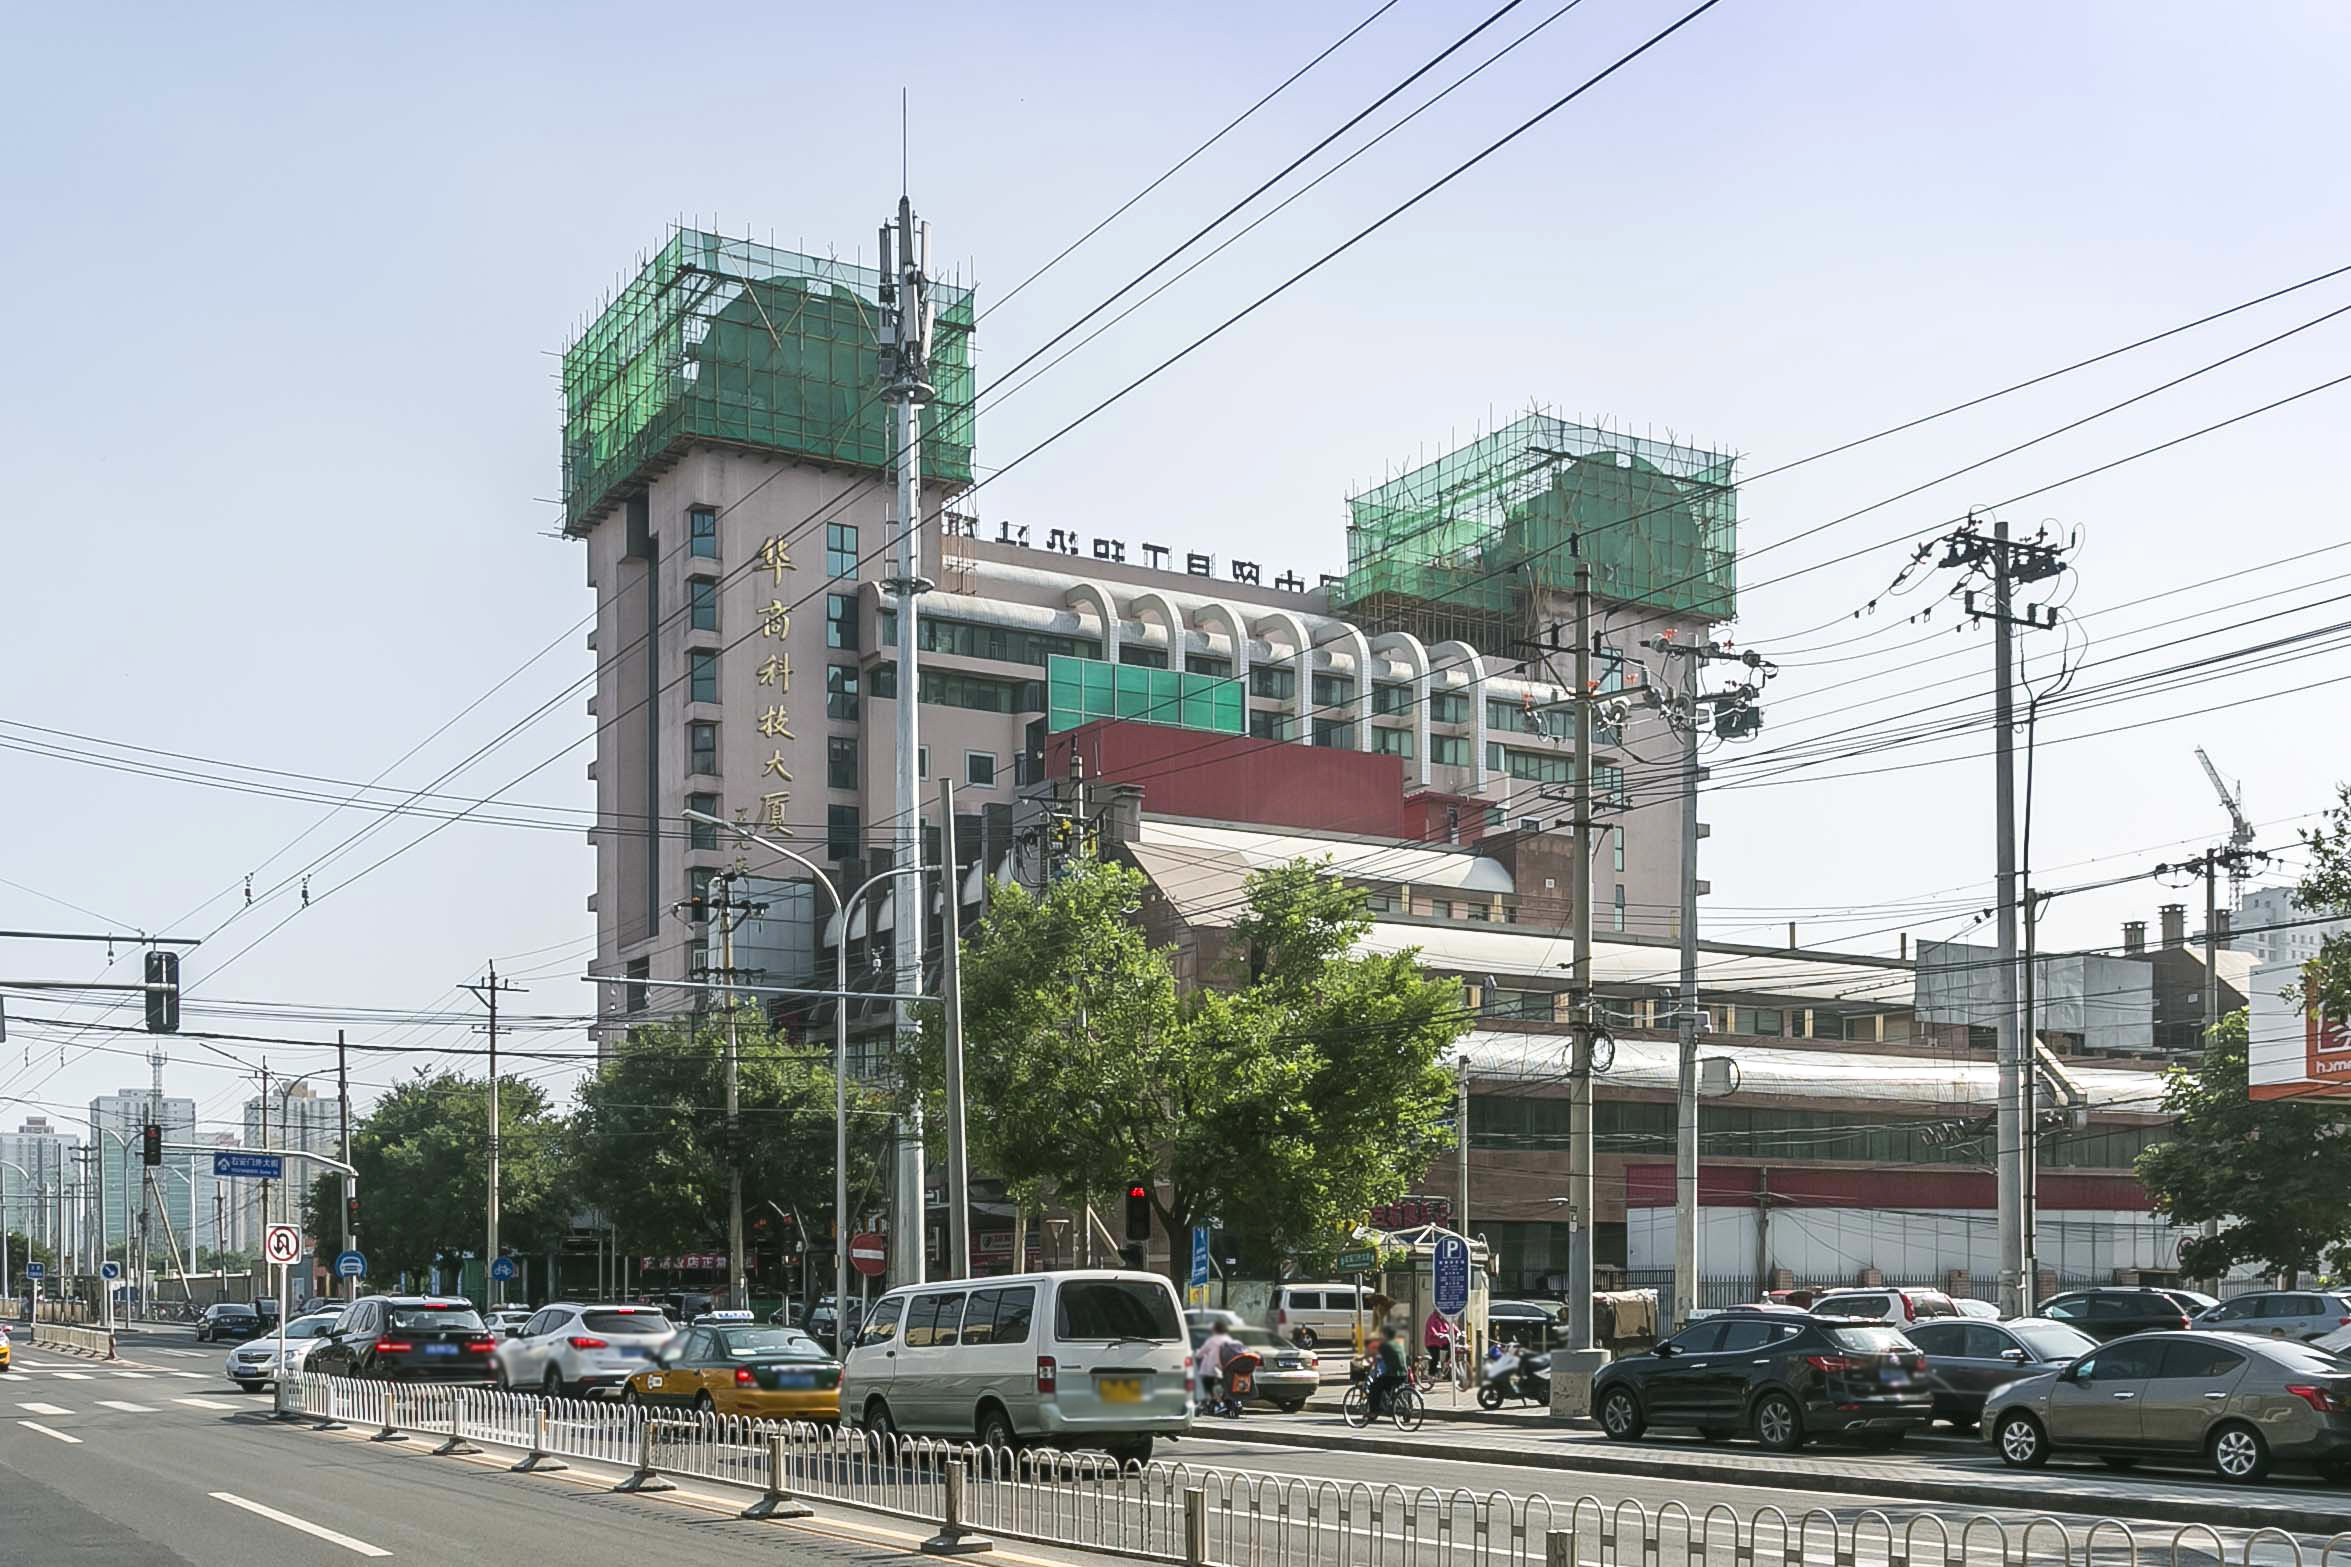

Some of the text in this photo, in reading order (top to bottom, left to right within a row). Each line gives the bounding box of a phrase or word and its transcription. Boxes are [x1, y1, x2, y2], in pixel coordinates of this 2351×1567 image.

[752, 534, 799, 837] 华商科技大厦
[1447, 1240, 1459, 1258] P
